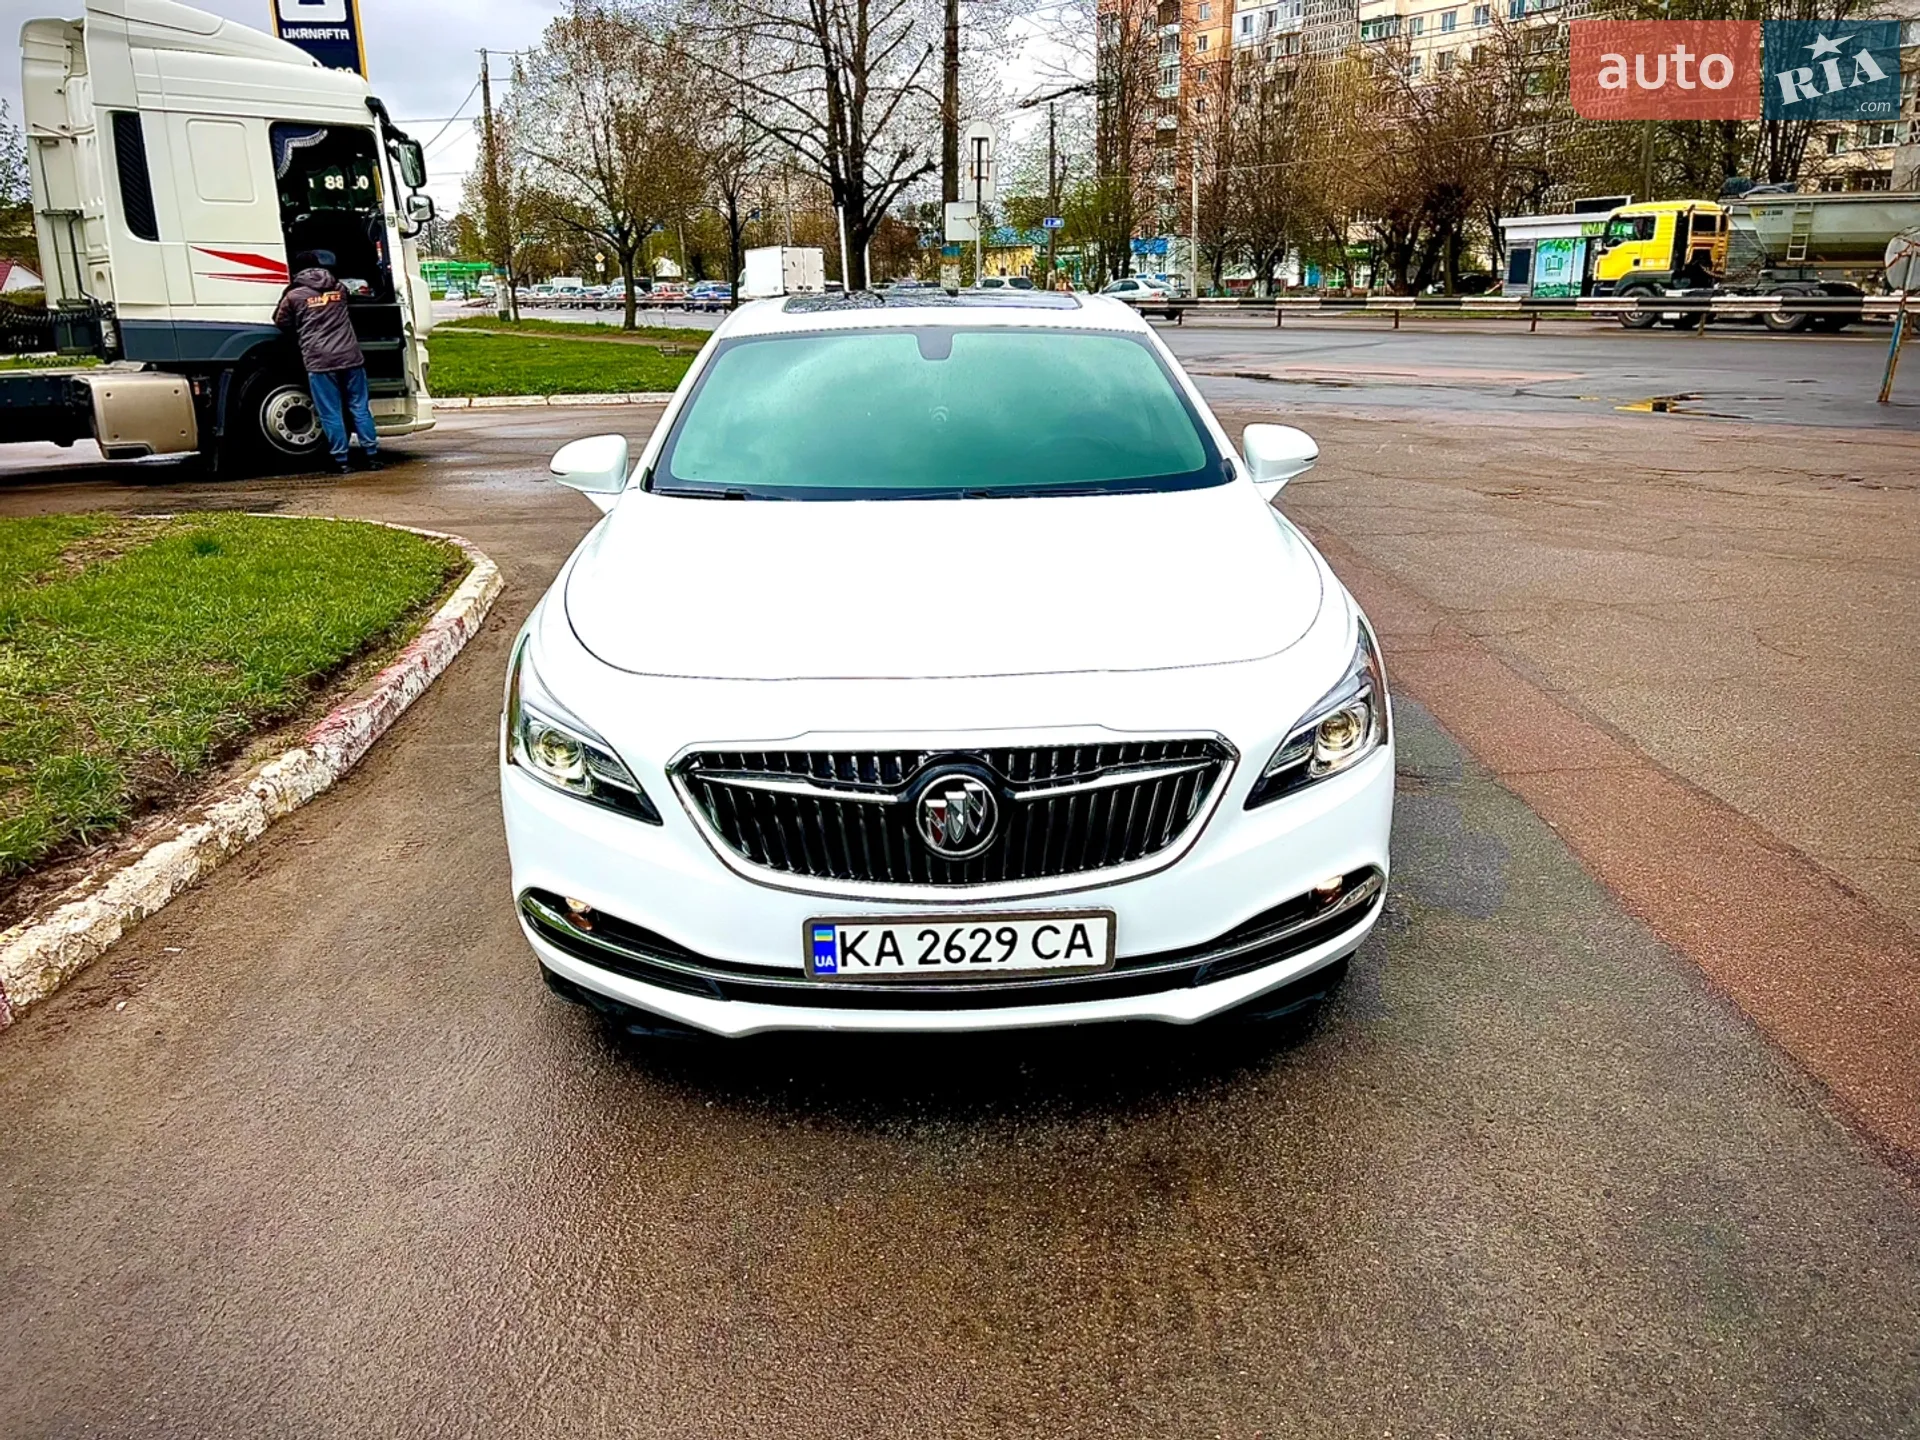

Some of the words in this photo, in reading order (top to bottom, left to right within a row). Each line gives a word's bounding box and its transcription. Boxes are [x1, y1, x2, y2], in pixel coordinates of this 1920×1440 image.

[282, 28, 350, 40] UKRNAFTA
[839, 930, 904, 967] KA
[917, 926, 1018, 965] 2629
[1031, 923, 1093, 960] CA
[815, 955, 834, 967] UA
